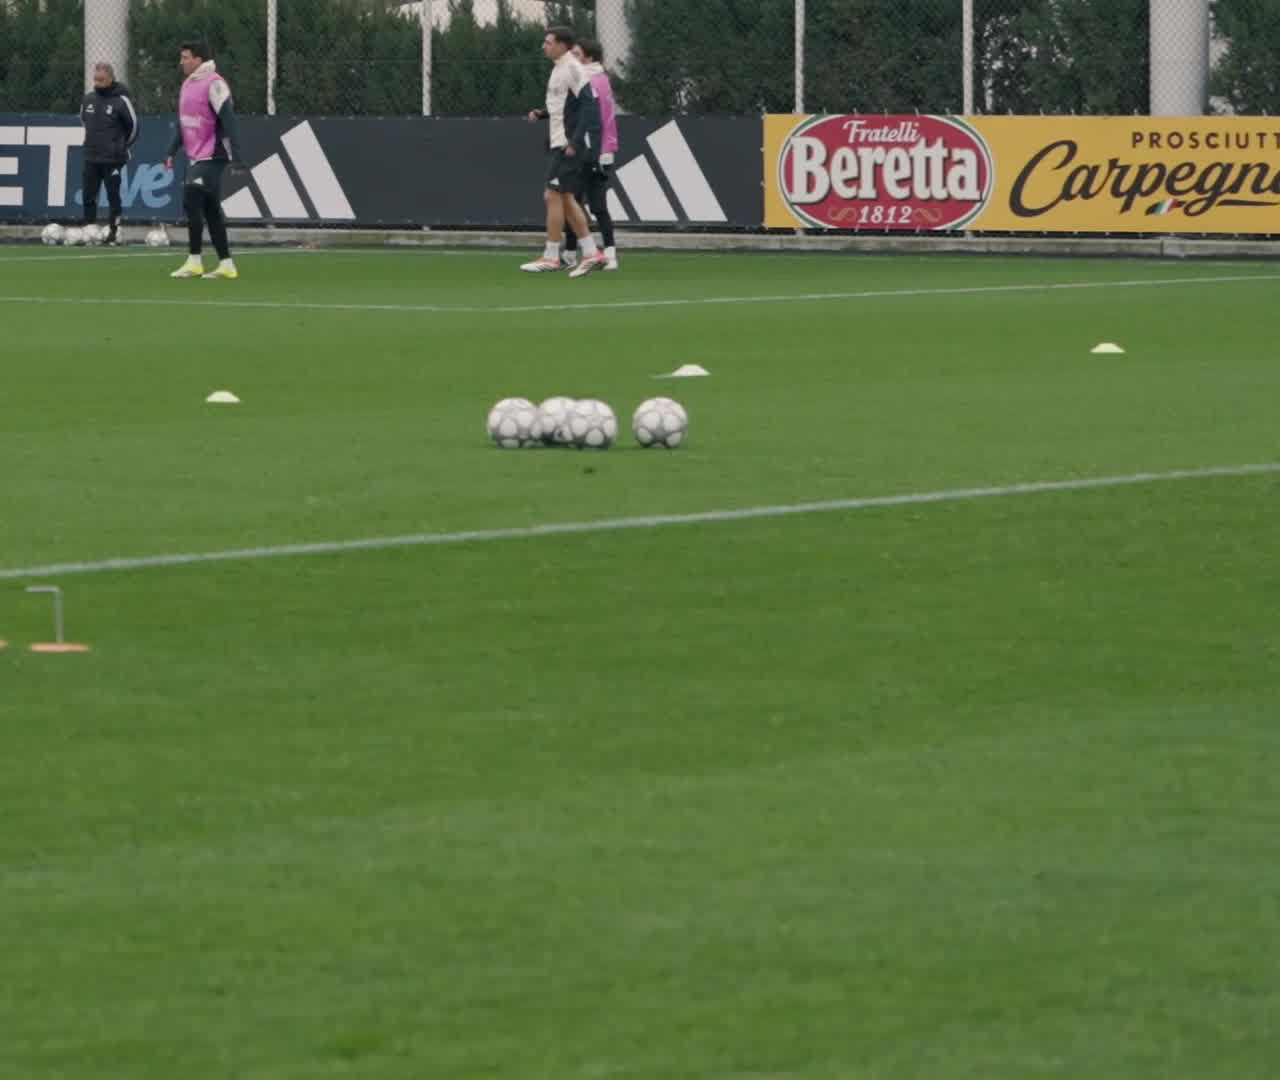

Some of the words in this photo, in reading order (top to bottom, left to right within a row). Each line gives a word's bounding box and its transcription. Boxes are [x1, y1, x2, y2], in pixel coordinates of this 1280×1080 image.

[842, 120, 921, 143] Fratelli
[789, 136, 984, 204] Beretta
[858, 205, 913, 224] 1812
